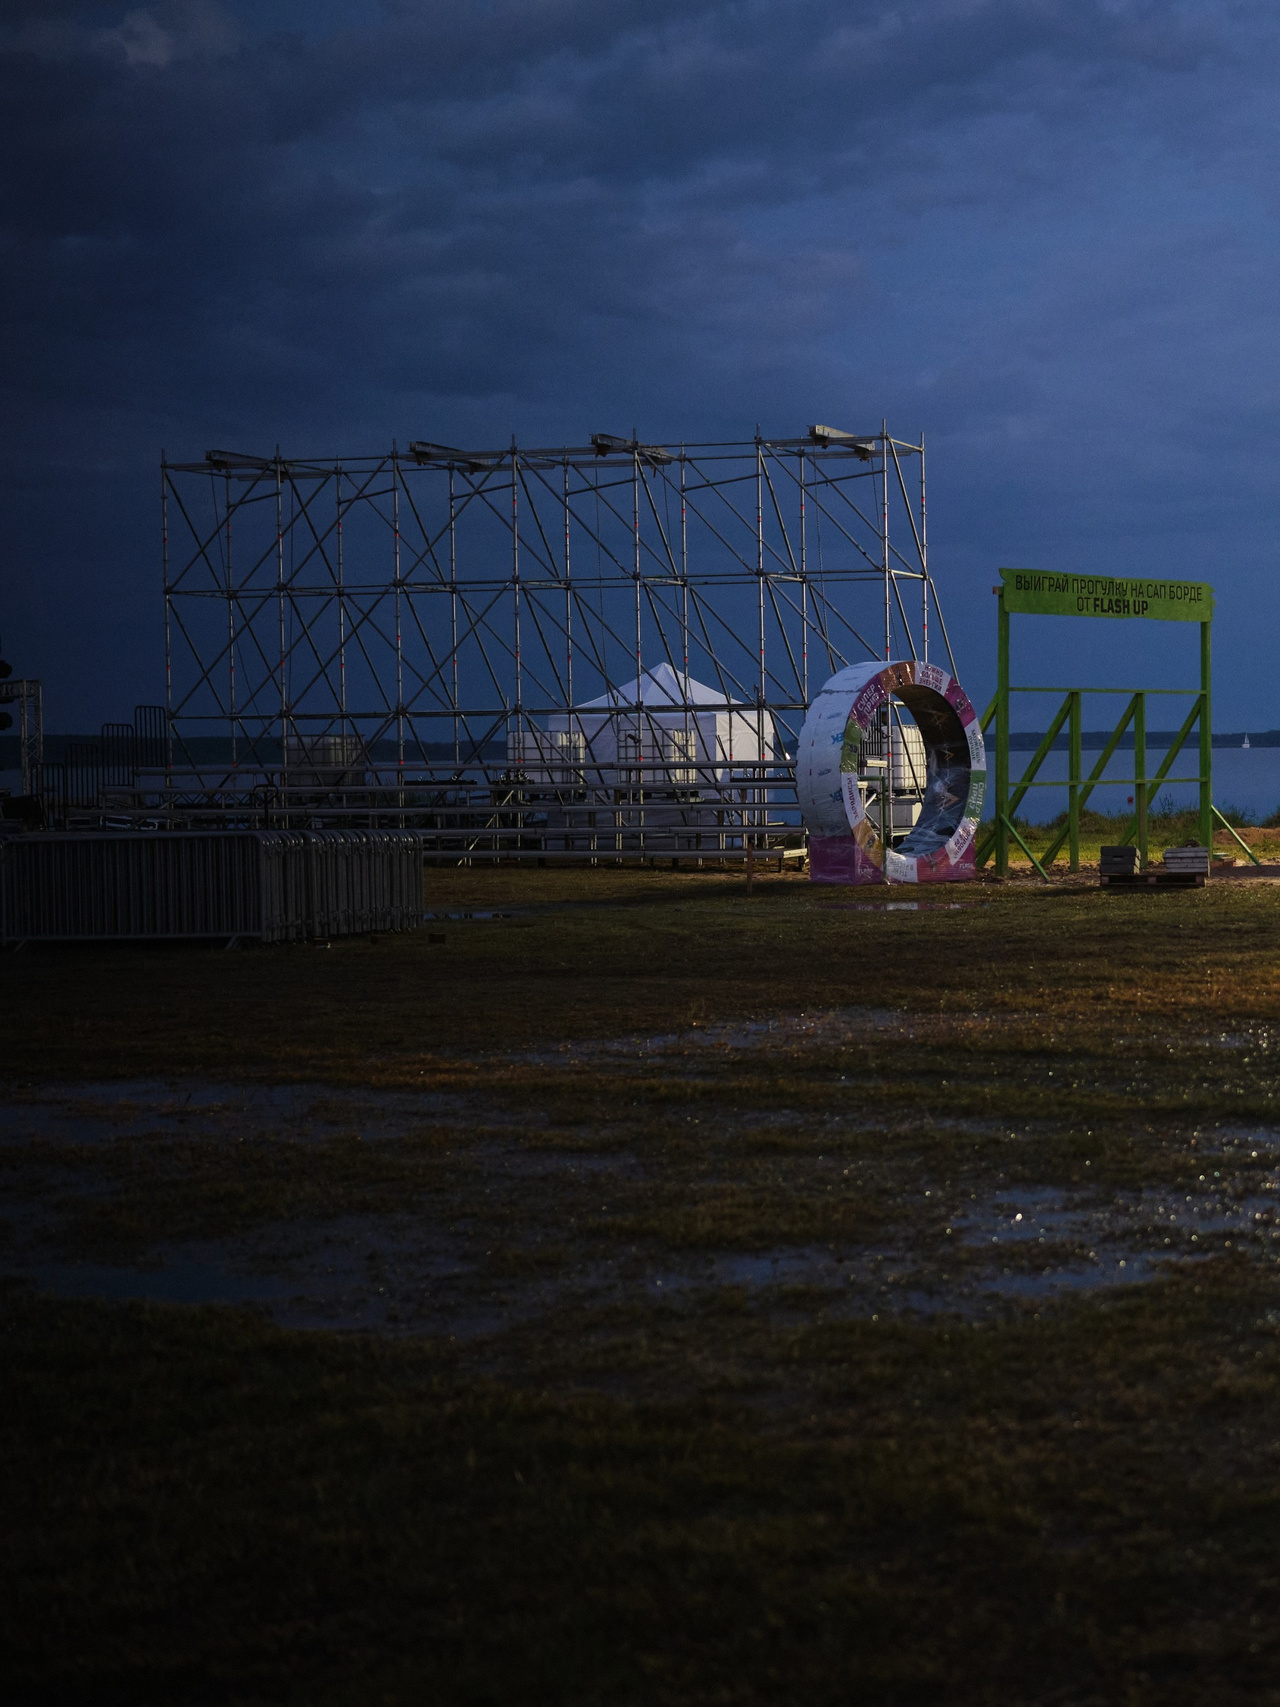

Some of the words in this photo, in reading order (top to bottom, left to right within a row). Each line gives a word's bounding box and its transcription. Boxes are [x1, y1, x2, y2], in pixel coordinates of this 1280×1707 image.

[1015, 574, 1069, 593] ВЫИГРАЙ
[1071, 578, 1128, 597] ПРОГУЛКУ
[1131, 584, 1144, 598] НА
[1146, 585, 1166, 599] САП
[1169, 586, 1203, 603] БОРДЕ
[1077, 597, 1091, 612] ОТ
[1094, 598, 1130, 614] FLASH
[1133, 599, 1148, 615] UP
[857, 683, 876, 712] СУПЕР
[974, 781, 984, 814] СУПЕР
